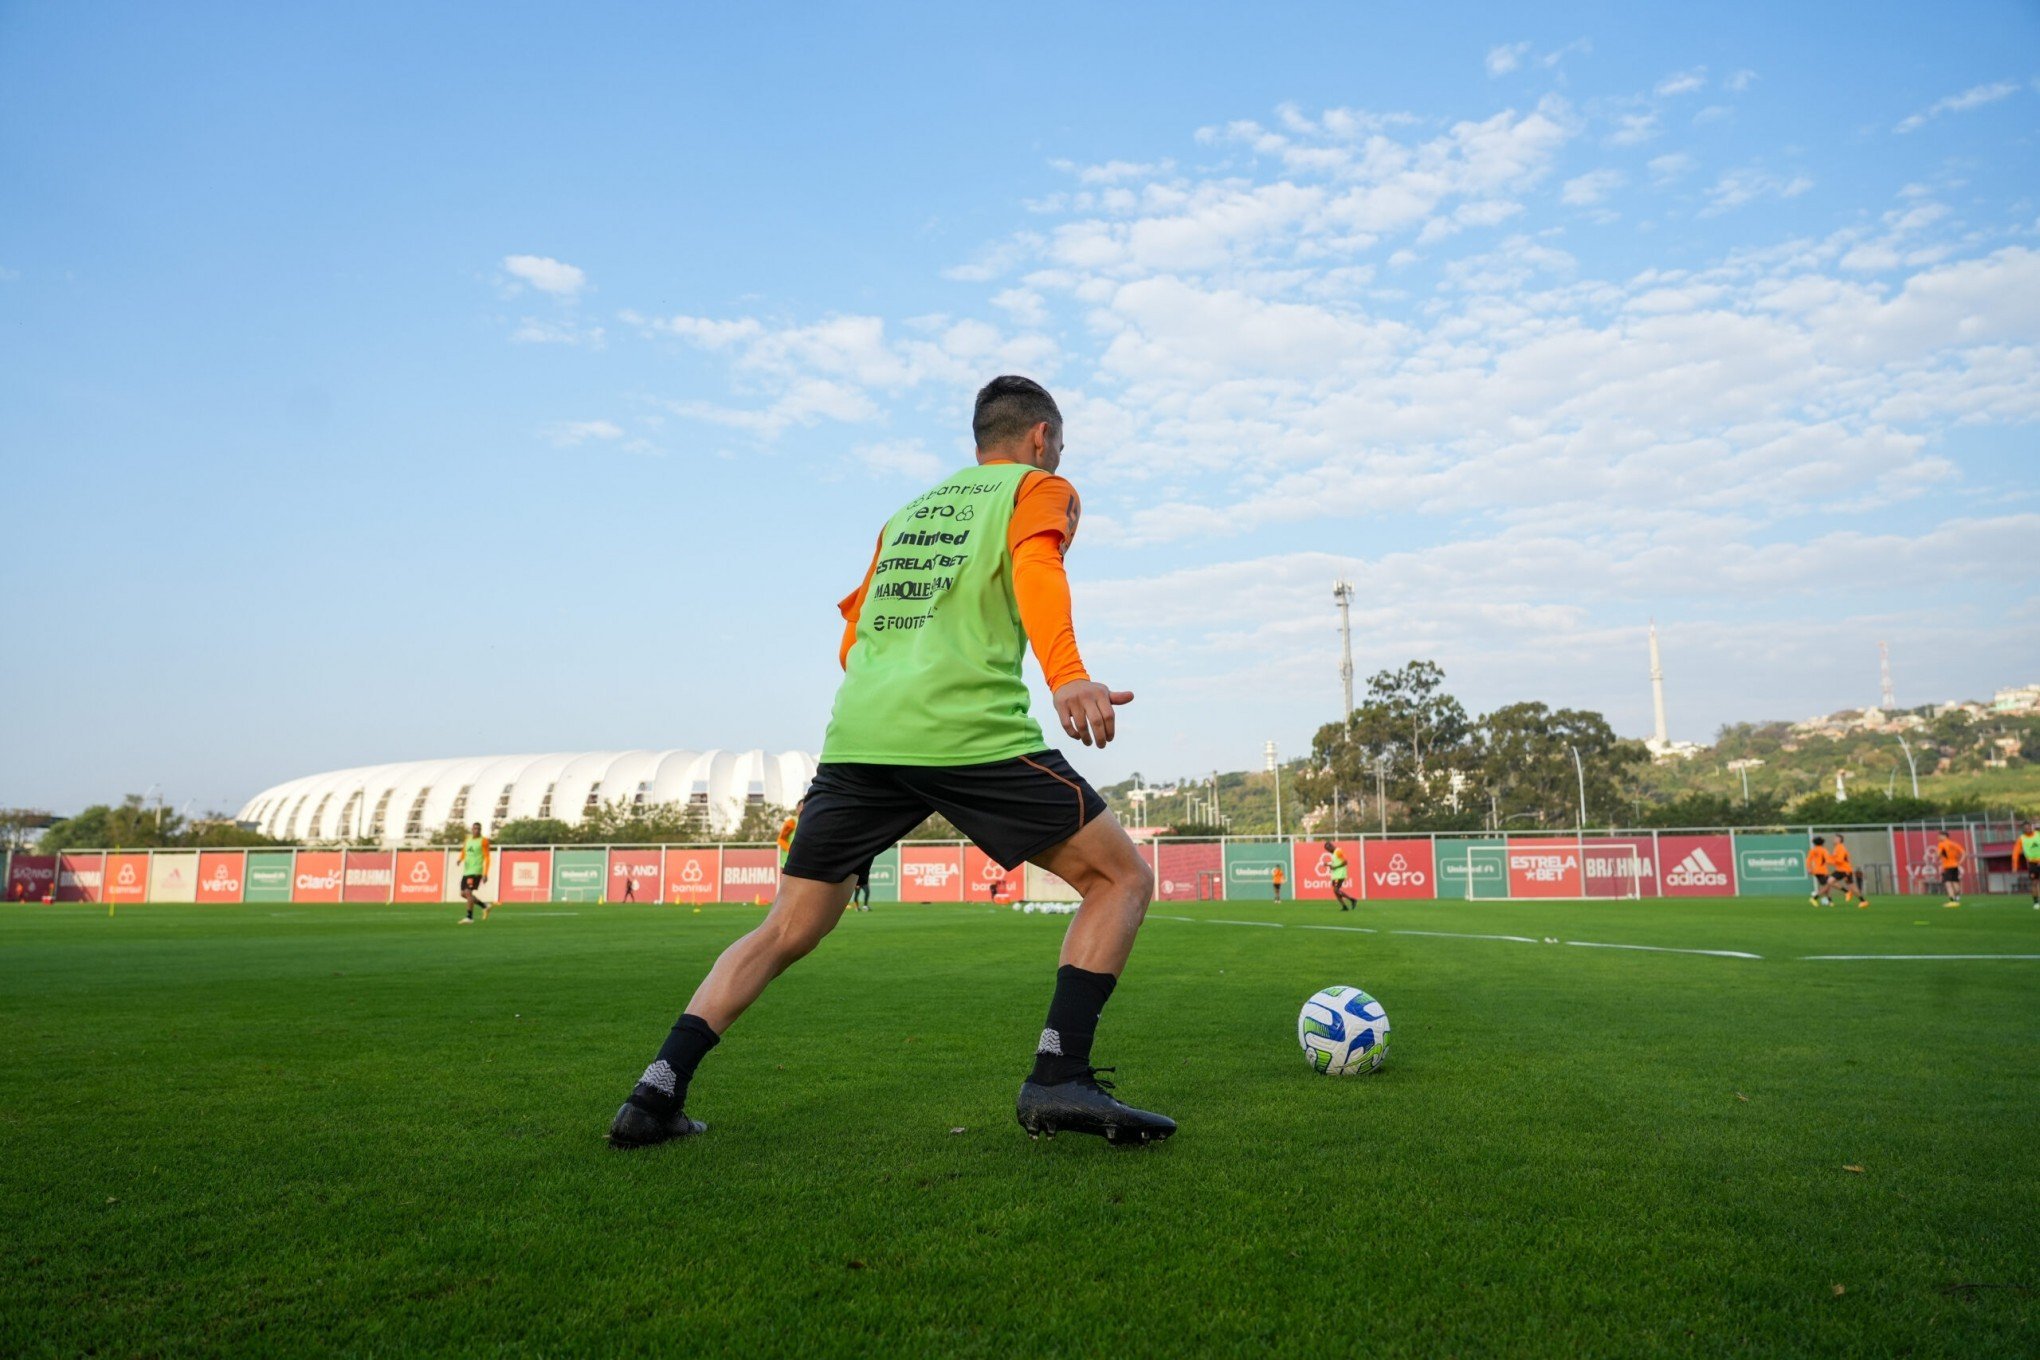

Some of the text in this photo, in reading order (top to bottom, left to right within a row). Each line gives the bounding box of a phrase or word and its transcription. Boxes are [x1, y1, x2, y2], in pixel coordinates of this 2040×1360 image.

[1510, 855, 1577, 869] ESTRELA
[724, 867, 776, 885] BRAHMA
[903, 863, 960, 876] ESTRELA
[1536, 868, 1565, 881] BET
[296, 874, 335, 889] Claro
[346, 869, 390, 885] BRAHMA
[924, 875, 950, 887] BET
[1373, 871, 1425, 886] vero
[1666, 871, 1727, 885] adidas
[202, 880, 238, 891] vero
[672, 882, 712, 893] banrisul
